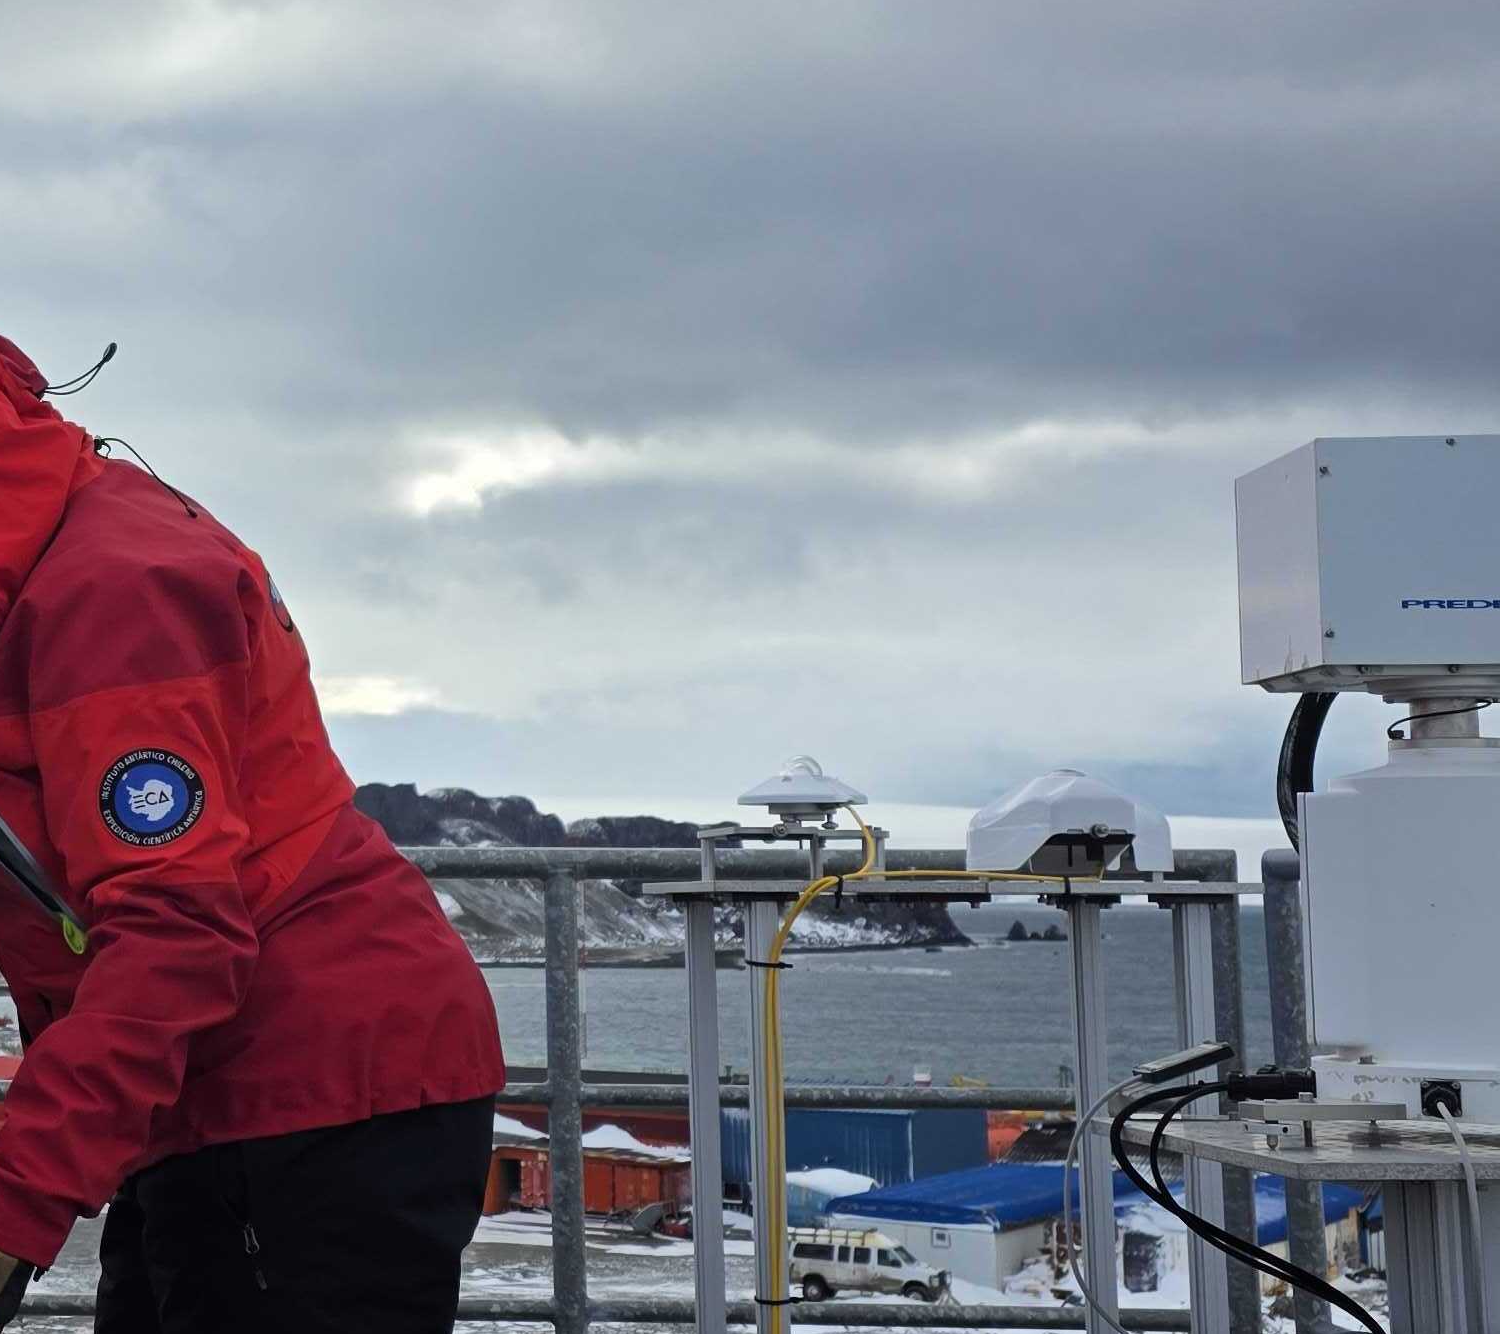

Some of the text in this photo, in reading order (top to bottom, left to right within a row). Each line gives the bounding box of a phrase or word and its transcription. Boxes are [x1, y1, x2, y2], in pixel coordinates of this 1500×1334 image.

[101, 762, 125, 800] INSTITUTO
[166, 755, 195, 780] CHILENO
[103, 809, 140, 845] EXPEDICIÓN
